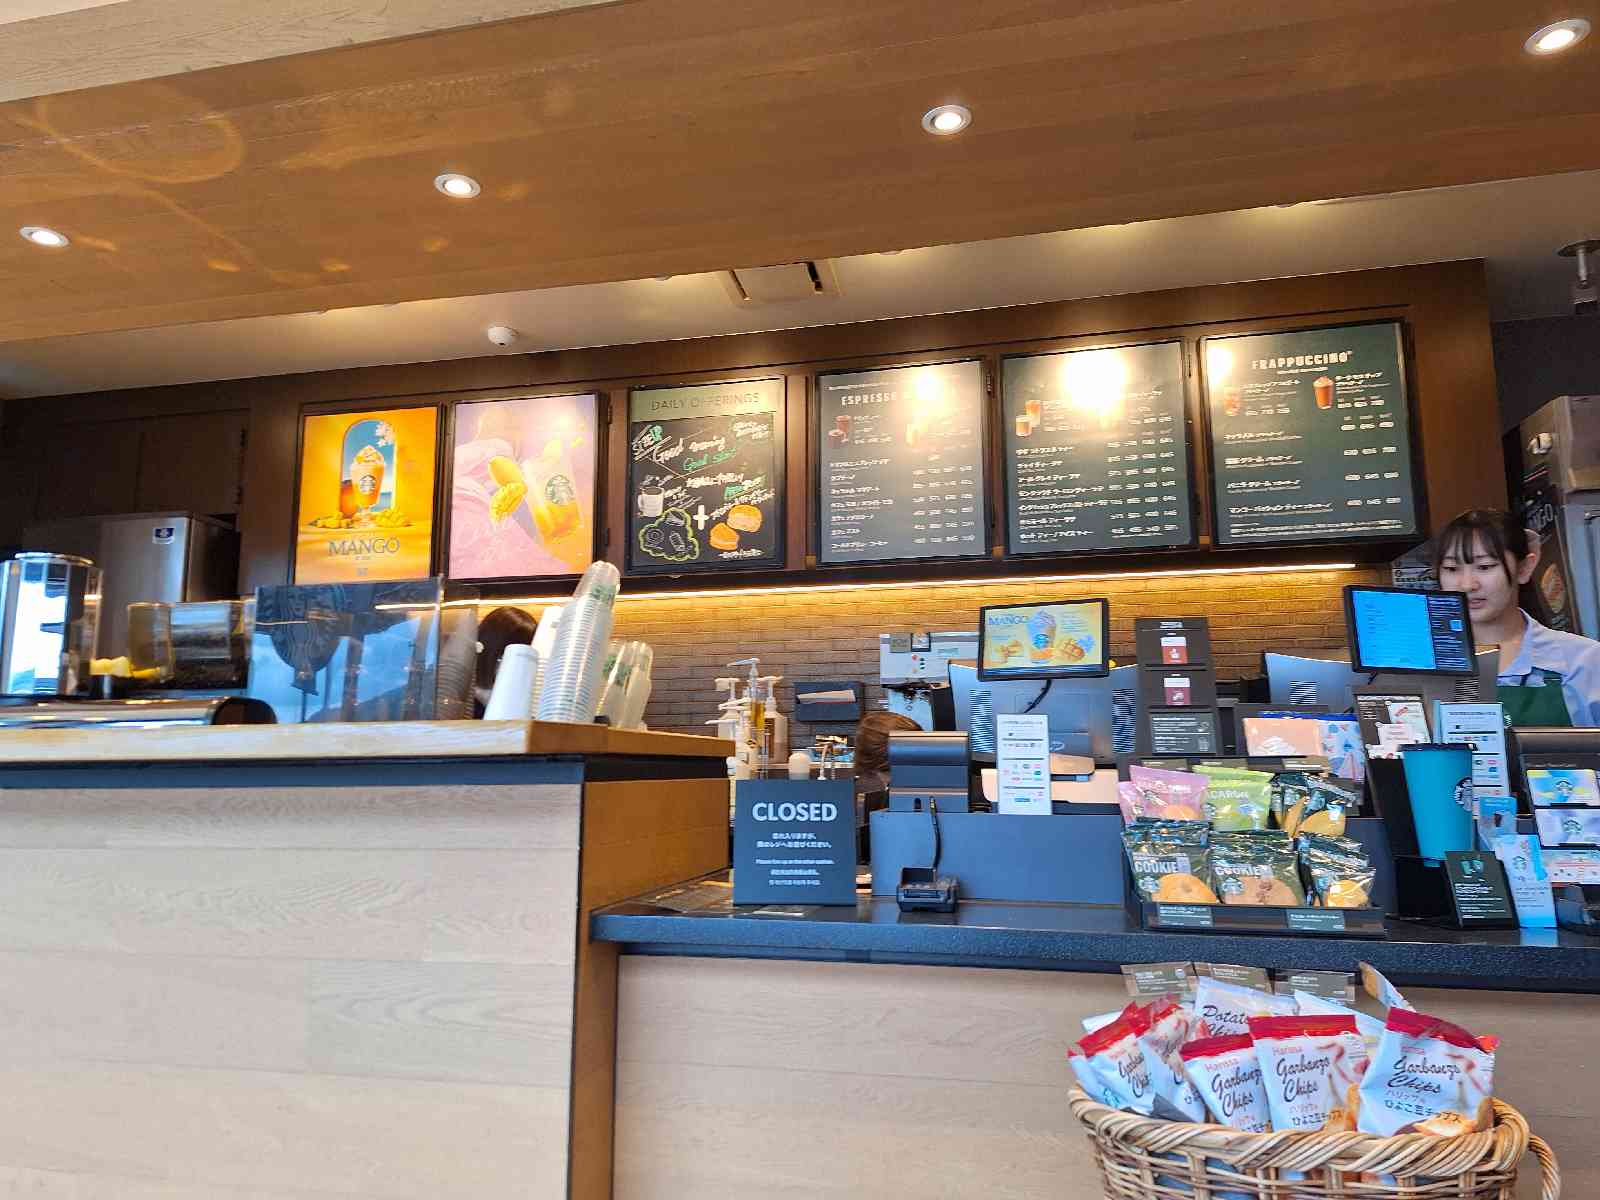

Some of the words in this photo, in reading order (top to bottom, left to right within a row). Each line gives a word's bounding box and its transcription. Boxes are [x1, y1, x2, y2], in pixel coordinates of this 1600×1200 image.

[651, 399, 685, 411] DAILY
[687, 392, 761, 409] OFFERINGS
[328, 538, 401, 558] MANGO
[752, 802, 838, 822] CLOSED
[1135, 861, 1178, 875] COOKIE
[1276, 1054, 1330, 1084] Garbanzo
[1393, 1055, 1461, 1080] Garbanzo
[1283, 1078, 1319, 1105] Chips
[1387, 1073, 1441, 1094] Chips
[1222, 1090, 1255, 1118] Chips
